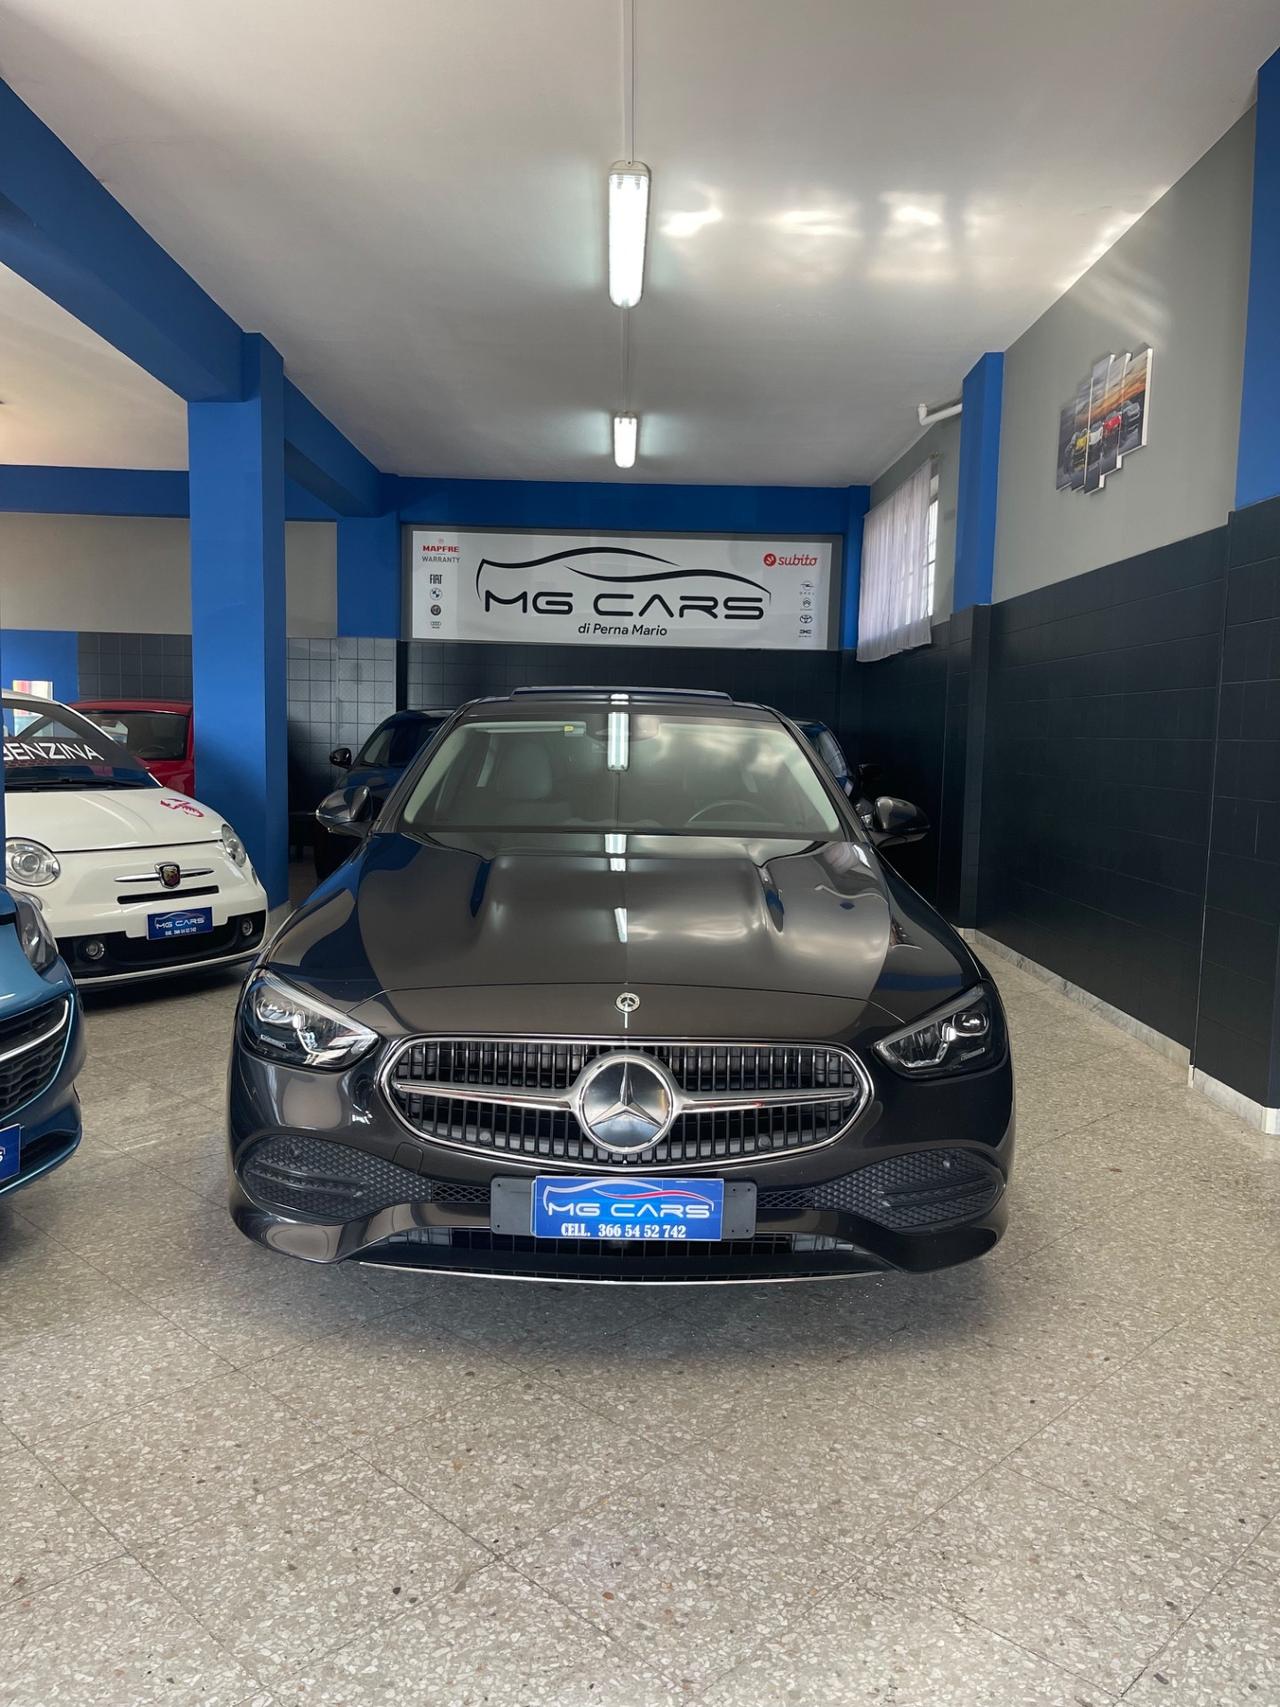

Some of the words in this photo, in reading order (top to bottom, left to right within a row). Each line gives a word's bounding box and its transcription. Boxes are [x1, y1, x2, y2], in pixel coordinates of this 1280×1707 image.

[422, 545, 460, 553] MAPFRE
[421, 556, 461, 564] WARRANTY
[778, 553, 818, 567] subito
[429, 574, 443, 585] FIAT
[484, 590, 573, 615] MG
[593, 593, 764, 620] CARS
[578, 623, 590, 634] di
[593, 624, 629, 635] Perna
[632, 625, 667, 636] Mario
[155, 921, 173, 930] MG
[175, 917, 205, 927] CARS
[547, 1202, 600, 1216] MG
[611, 1203, 710, 1218] CARS
[561, 1222, 591, 1237] CELL.
[598, 1223, 622, 1237] 366
[625, 1224, 640, 1237] 54
[644, 1224, 659, 1237] 52
[663, 1225, 687, 1238] 742
